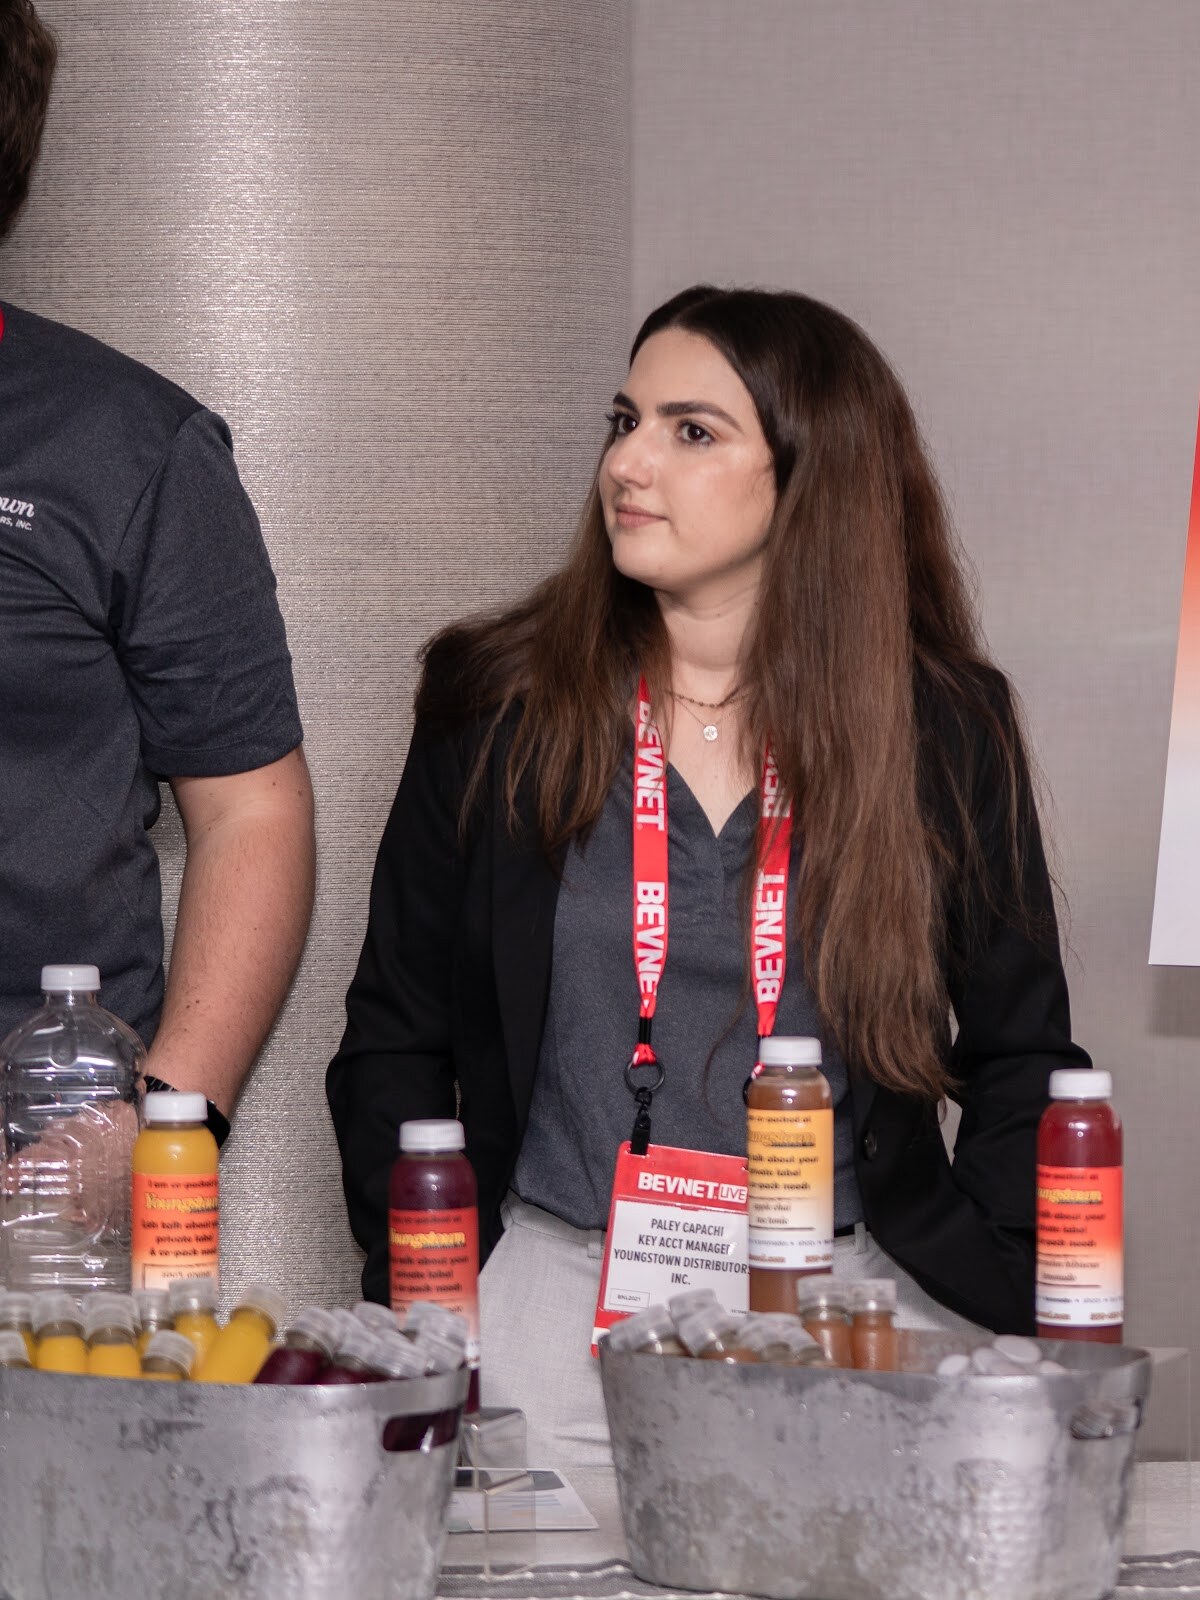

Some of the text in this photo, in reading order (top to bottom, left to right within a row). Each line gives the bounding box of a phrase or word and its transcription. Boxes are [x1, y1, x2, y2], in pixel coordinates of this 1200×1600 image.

[637, 881, 665, 1003] BEVNE
[755, 870, 785, 1004] BEVNET
[638, 1171, 746, 1201] BEVNET LIVE
[651, 1218, 724, 1237] PALEY CAPACHI
[638, 1234, 659, 1247] KEY
[659, 1236, 685, 1250] ACCT
[614, 1248, 681, 1267] YOUNGSTOWN
[671, 1273, 691, 1285] INC.
